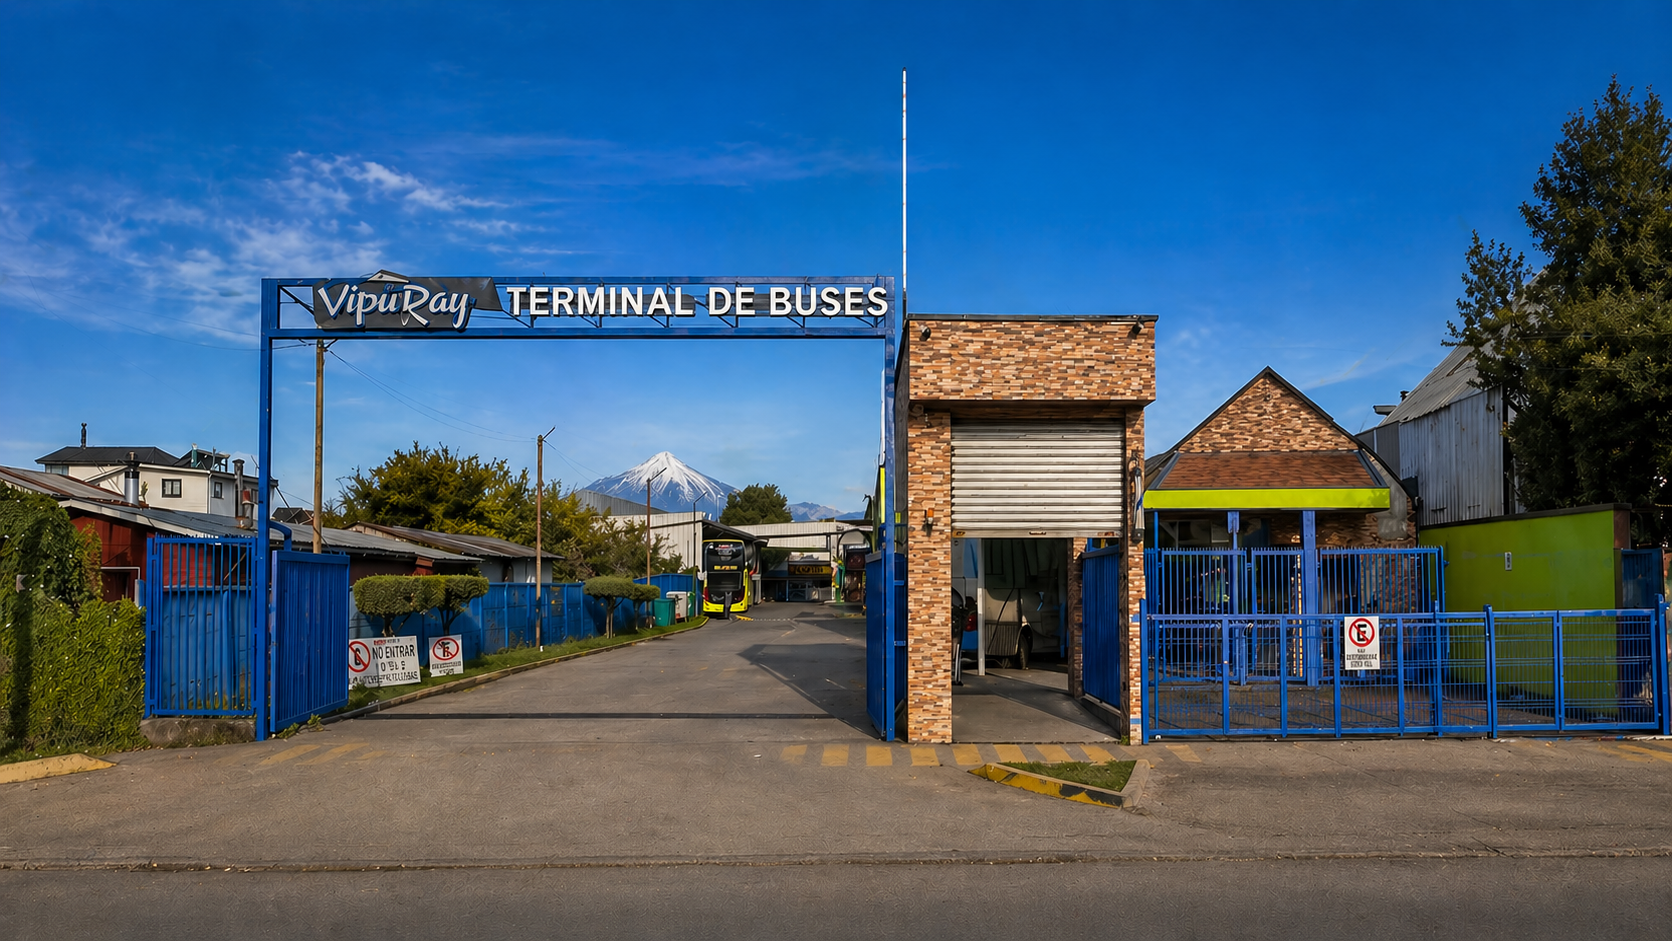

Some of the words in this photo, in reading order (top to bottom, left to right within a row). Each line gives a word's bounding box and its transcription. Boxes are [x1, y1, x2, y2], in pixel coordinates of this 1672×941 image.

[506, 286, 695, 316] TERMINAL
[708, 286, 756, 316] DE
[769, 286, 889, 316] BUSES
[372, 646, 384, 660] NO
[385, 644, 416, 659] ENTRAR
